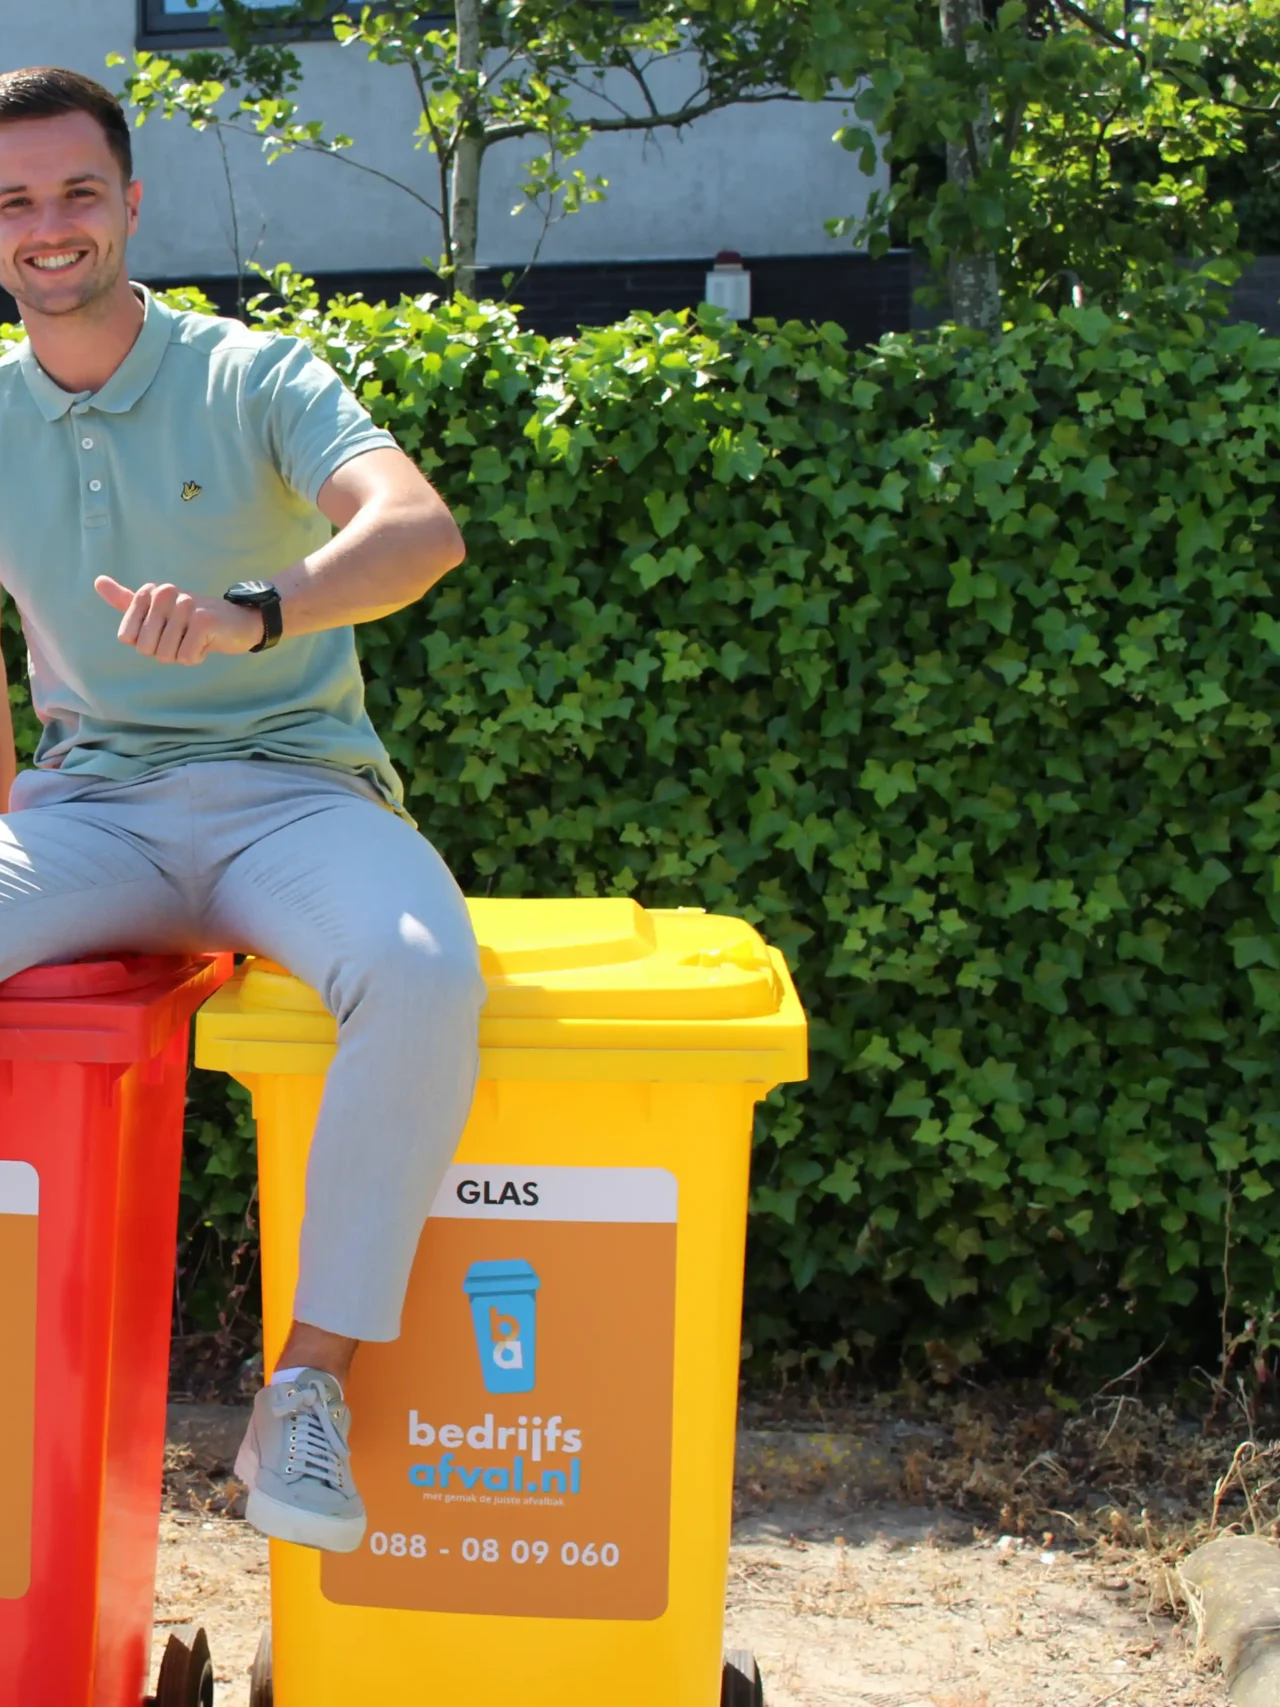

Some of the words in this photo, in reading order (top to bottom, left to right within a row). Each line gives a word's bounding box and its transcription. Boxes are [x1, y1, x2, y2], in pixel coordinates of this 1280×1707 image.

[456, 1179, 539, 1206] GLAS
[408, 1409, 582, 1462] bedrijfs
[408, 1452, 581, 1494] afval.nl
[423, 1492, 442, 1501] met
[444, 1493, 477, 1504] gemak
[479, 1494, 491, 1504] de
[493, 1495, 520, 1506] juiste
[523, 1496, 565, 1507] afvalbak
[370, 1531, 427, 1559] 088
[461, 1537, 500, 1563] 08
[511, 1539, 550, 1565] 09
[560, 1541, 620, 1567] 060
